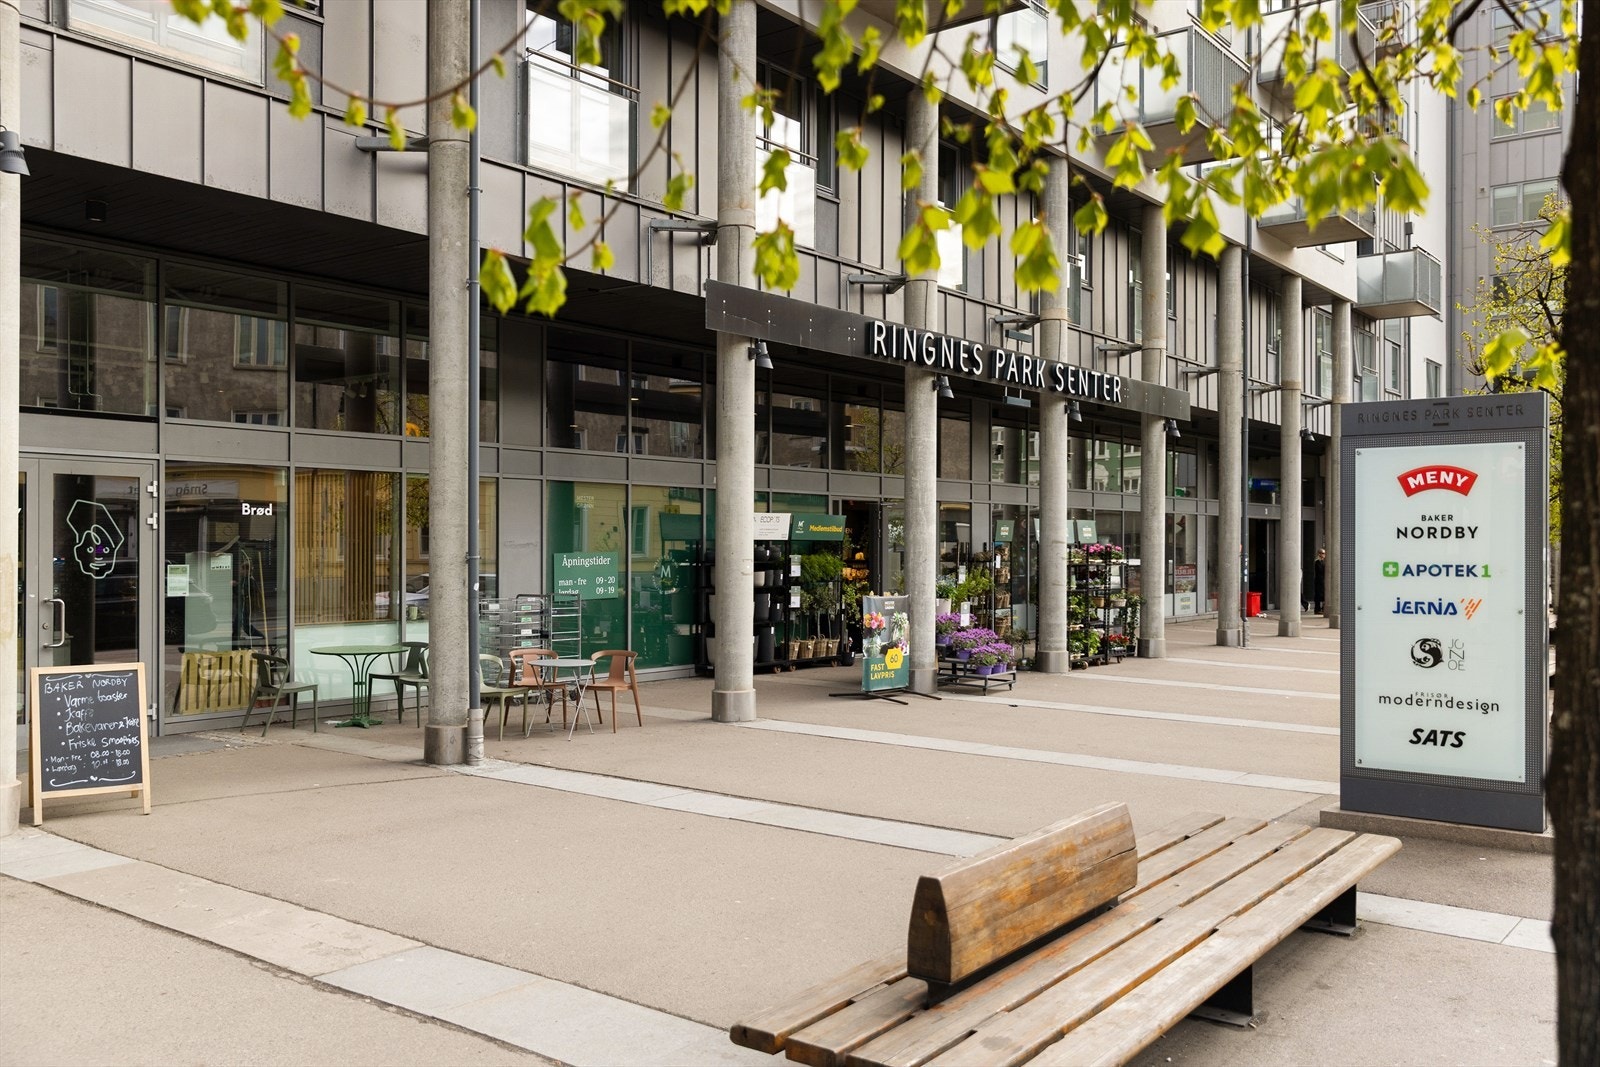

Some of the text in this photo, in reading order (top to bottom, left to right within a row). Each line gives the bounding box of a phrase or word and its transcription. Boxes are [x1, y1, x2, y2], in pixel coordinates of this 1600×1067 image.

[872, 320, 1122, 403] RINGNES PARK SENTER
[1358, 404, 1525, 423] RINGNES PARK SENTER
[1406, 470, 1470, 489] MENY
[241, 503, 273, 516] Brød
[1421, 514, 1454, 522] BAKER
[809, 524, 843, 533] Medlemstilbud
[1396, 526, 1479, 539] NORDBY
[562, 554, 611, 568] Åpningstider
[1402, 563, 1492, 578] APOTEK 1
[889, 654, 899, 663] 60
[870, 663, 885, 672] FAST
[870, 671, 895, 680] LAVPRIS
[44, 678, 128, 694] BAKER NORDBY
[64, 693, 95, 708] Varme
[1378, 694, 1500, 715] moderndesign
[1409, 728, 1467, 749] SATS
